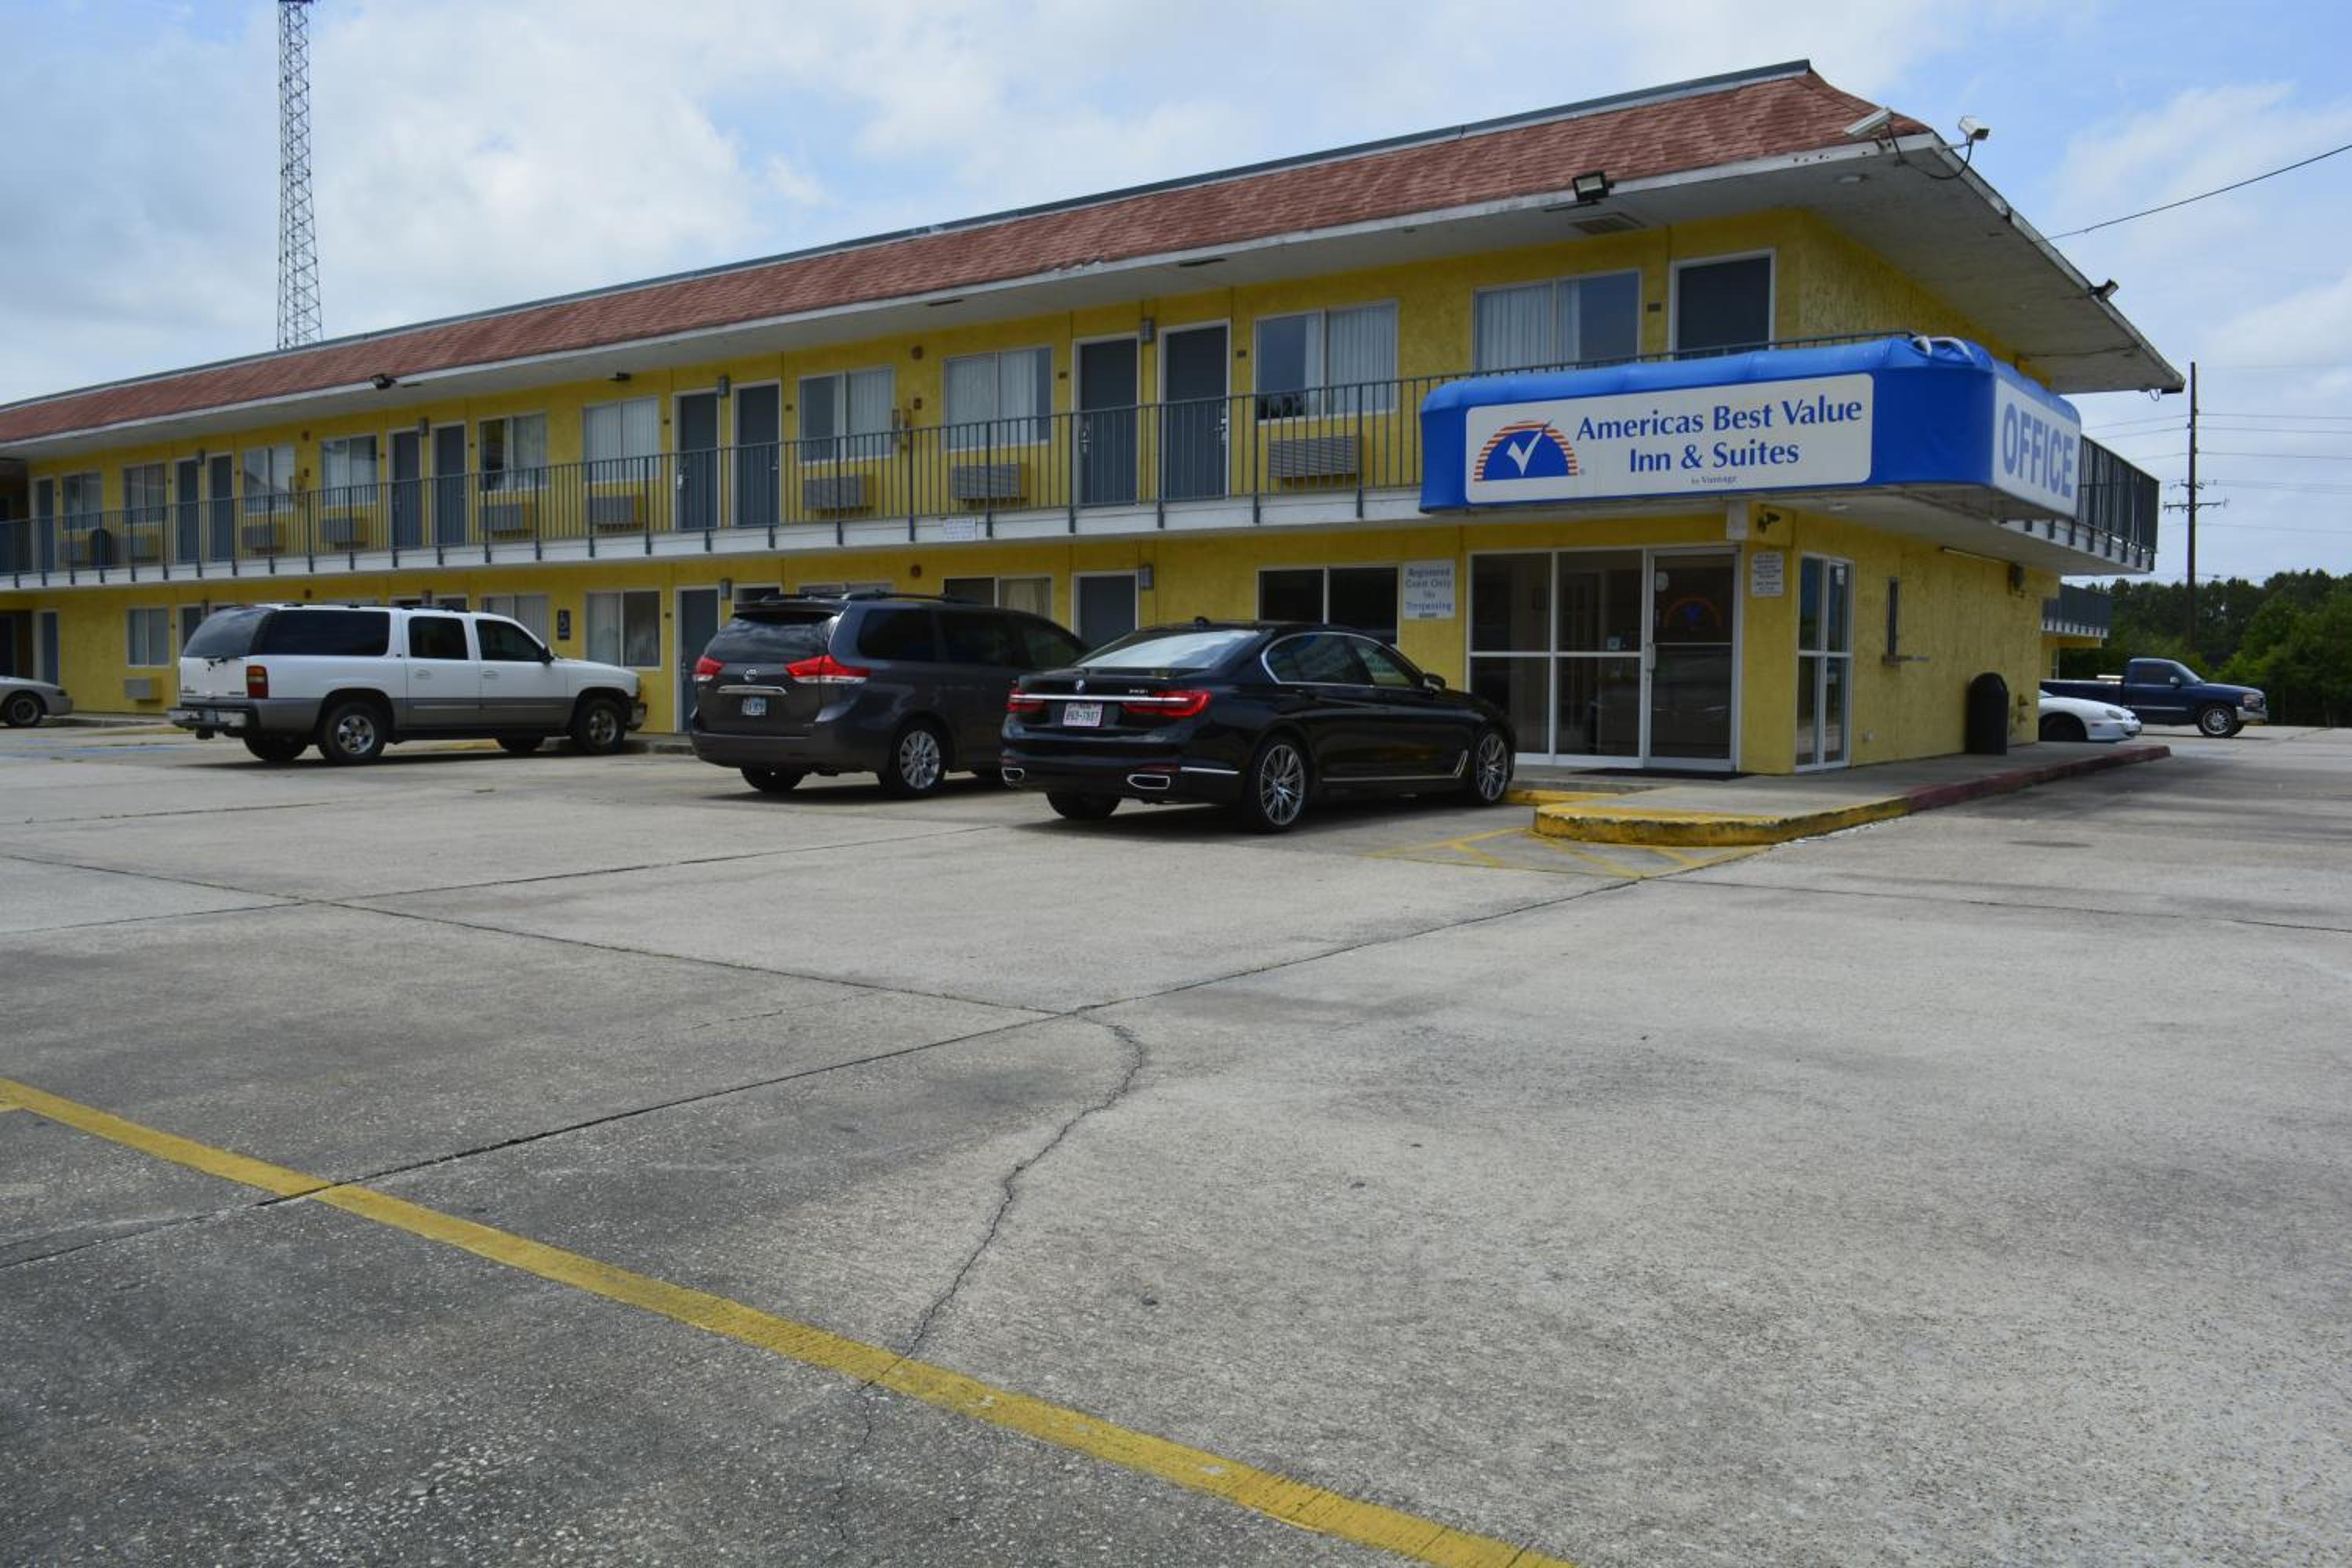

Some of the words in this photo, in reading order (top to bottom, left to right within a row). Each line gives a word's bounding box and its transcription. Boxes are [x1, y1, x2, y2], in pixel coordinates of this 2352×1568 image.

[1577, 408, 1704, 441] Americas
[1713, 403, 1773, 431] Best
[1781, 394, 1863, 426] Value
[1629, 448, 1671, 473] Inn
[1680, 444, 1704, 470] &
[1712, 439, 1800, 468] Suites
[2002, 402, 2074, 499] OFFICE
